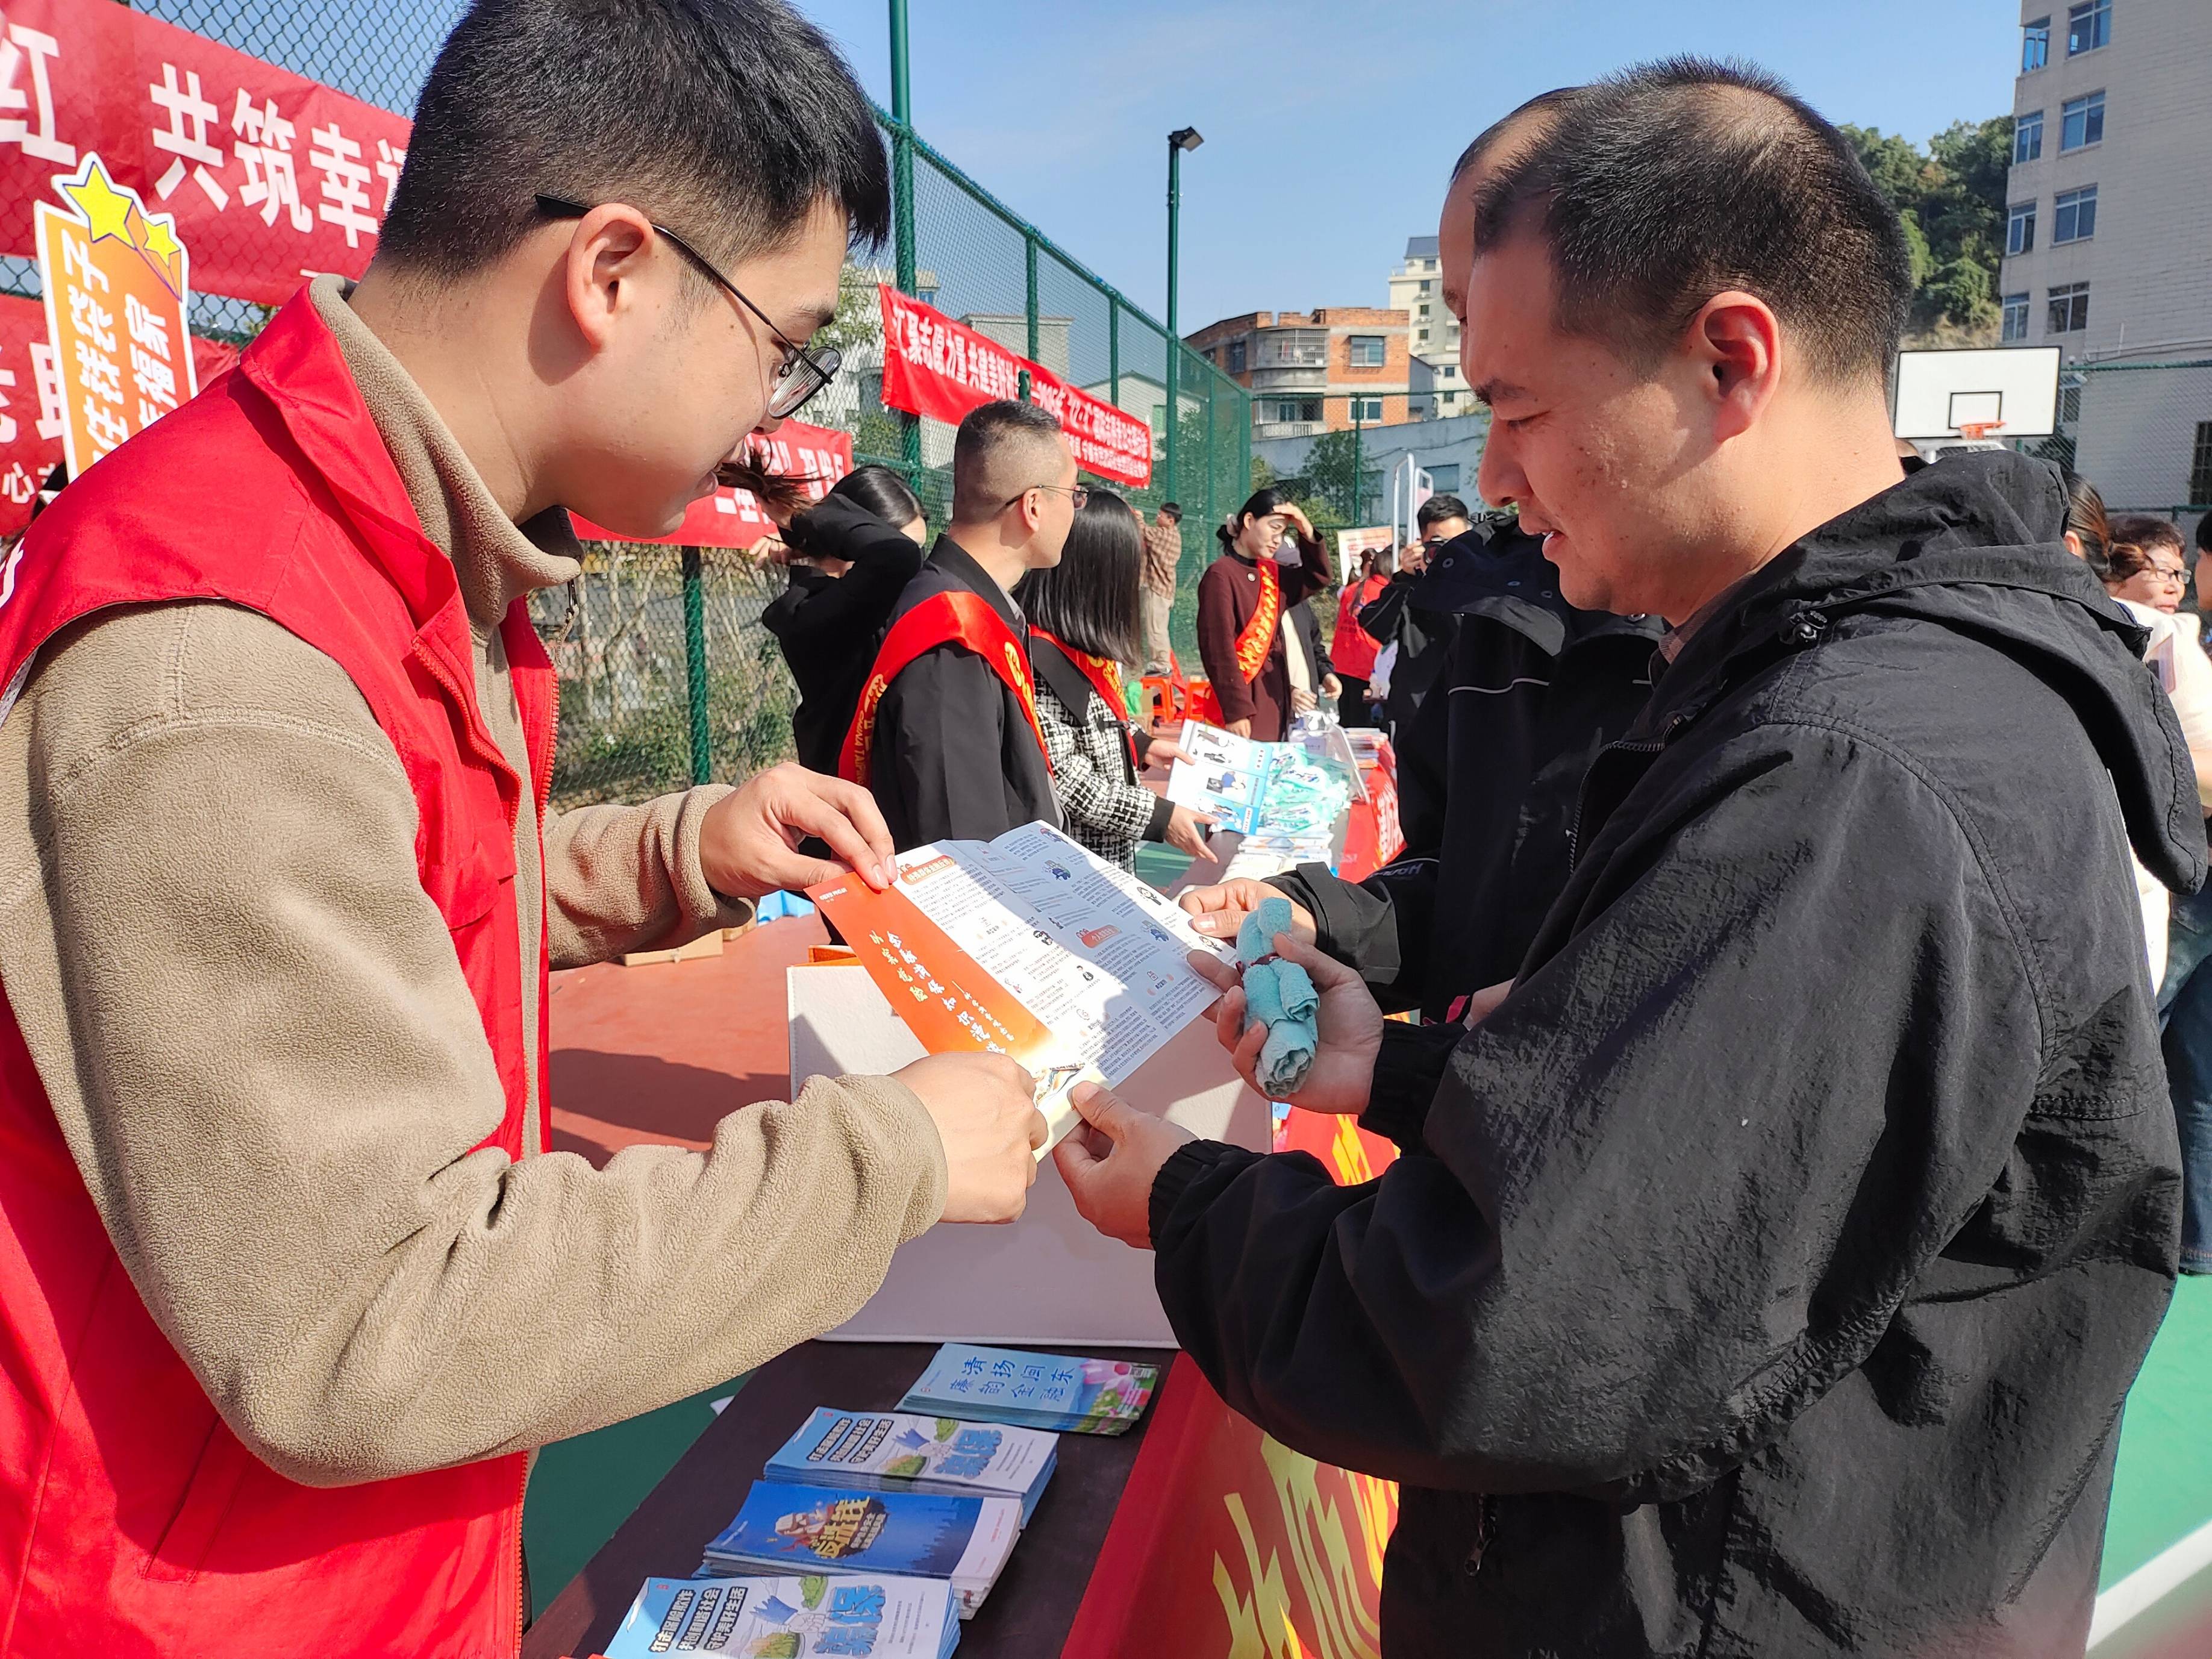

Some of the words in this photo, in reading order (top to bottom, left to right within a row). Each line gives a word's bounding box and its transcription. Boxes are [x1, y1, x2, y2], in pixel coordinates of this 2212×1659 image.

[149, 62, 410, 248] 共筑幸
[61, 230, 130, 465] 住钱袋子
[949, 1378, 1066, 1402] 廉韵金融
[960, 1355, 1076, 1386] 清扬闽东
[814, 1496, 870, 1558] 反洗钱
[648, 1589, 695, 1652] 打击保险欺诈
[676, 1588, 723, 1651] 共创和谐社会
[704, 1587, 748, 1651] 守护美好生活
